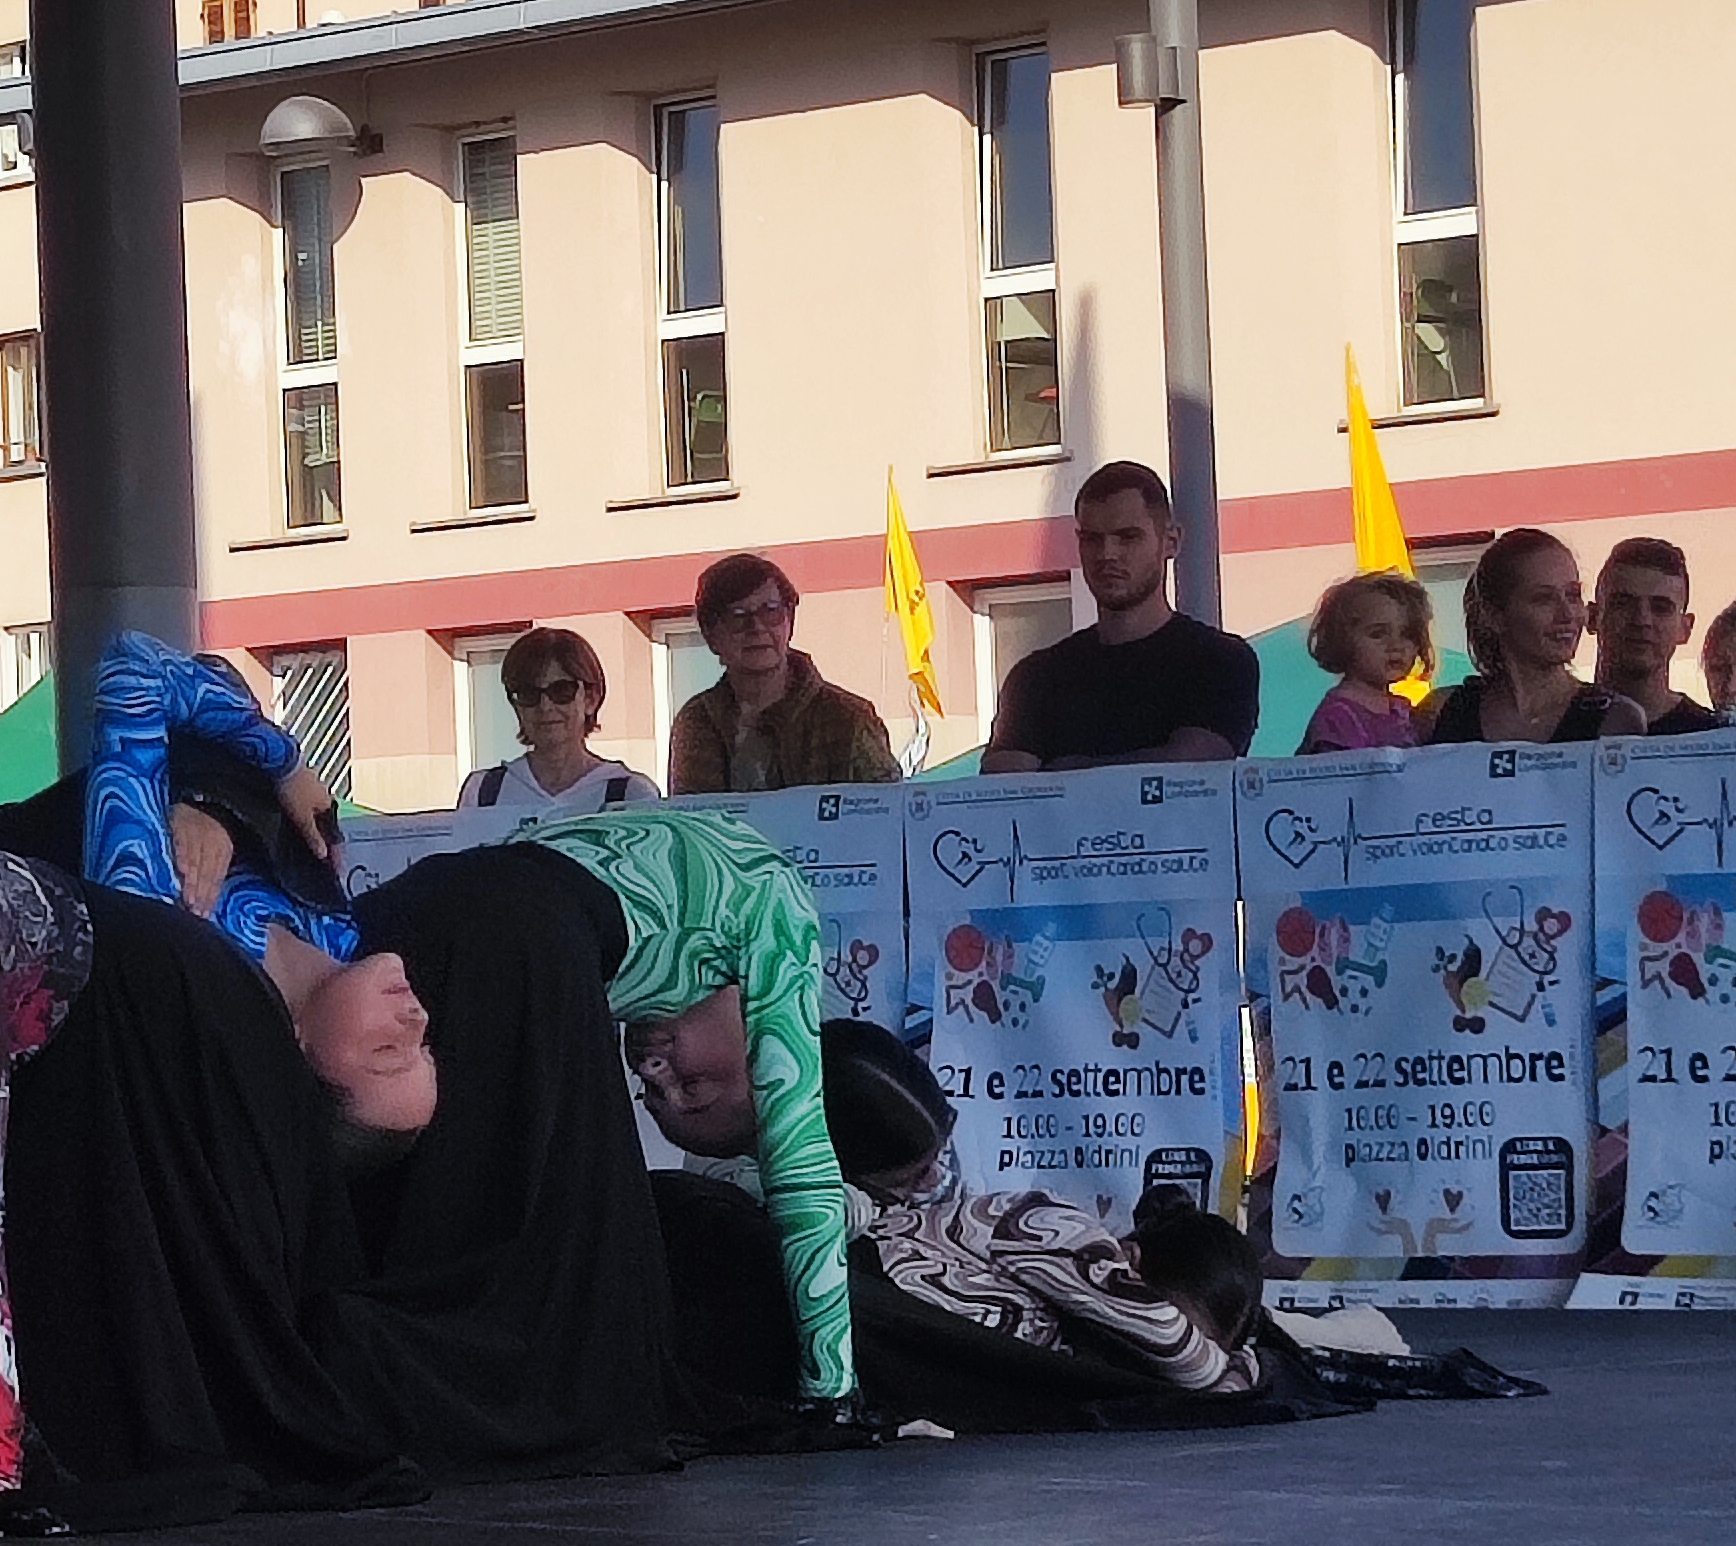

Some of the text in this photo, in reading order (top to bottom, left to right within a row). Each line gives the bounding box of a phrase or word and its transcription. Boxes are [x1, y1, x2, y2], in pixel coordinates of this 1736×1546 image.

[1076, 831, 1145, 858] festa
[936, 1064, 976, 1100] 21
[986, 1070, 1006, 1100] e
[1012, 1063, 1045, 1099] 22
[1049, 1059, 1207, 1099] settembre
[1280, 1054, 1319, 1092] 21
[1326, 1059, 1346, 1092] e
[1352, 1051, 1387, 1090] 22
[1393, 1044, 1567, 1088] settembre
[1635, 1044, 1679, 1085] 21
[1688, 1050, 1711, 1085] e
[999, 1111, 1060, 1140] 10.00
[1079, 1111, 1146, 1139] 19.00
[1343, 1101, 1401, 1133] 10.00
[1426, 1099, 1497, 1131] 19.00
[997, 1144, 1069, 1172] piazza
[1343, 1136, 1410, 1169] piazza
